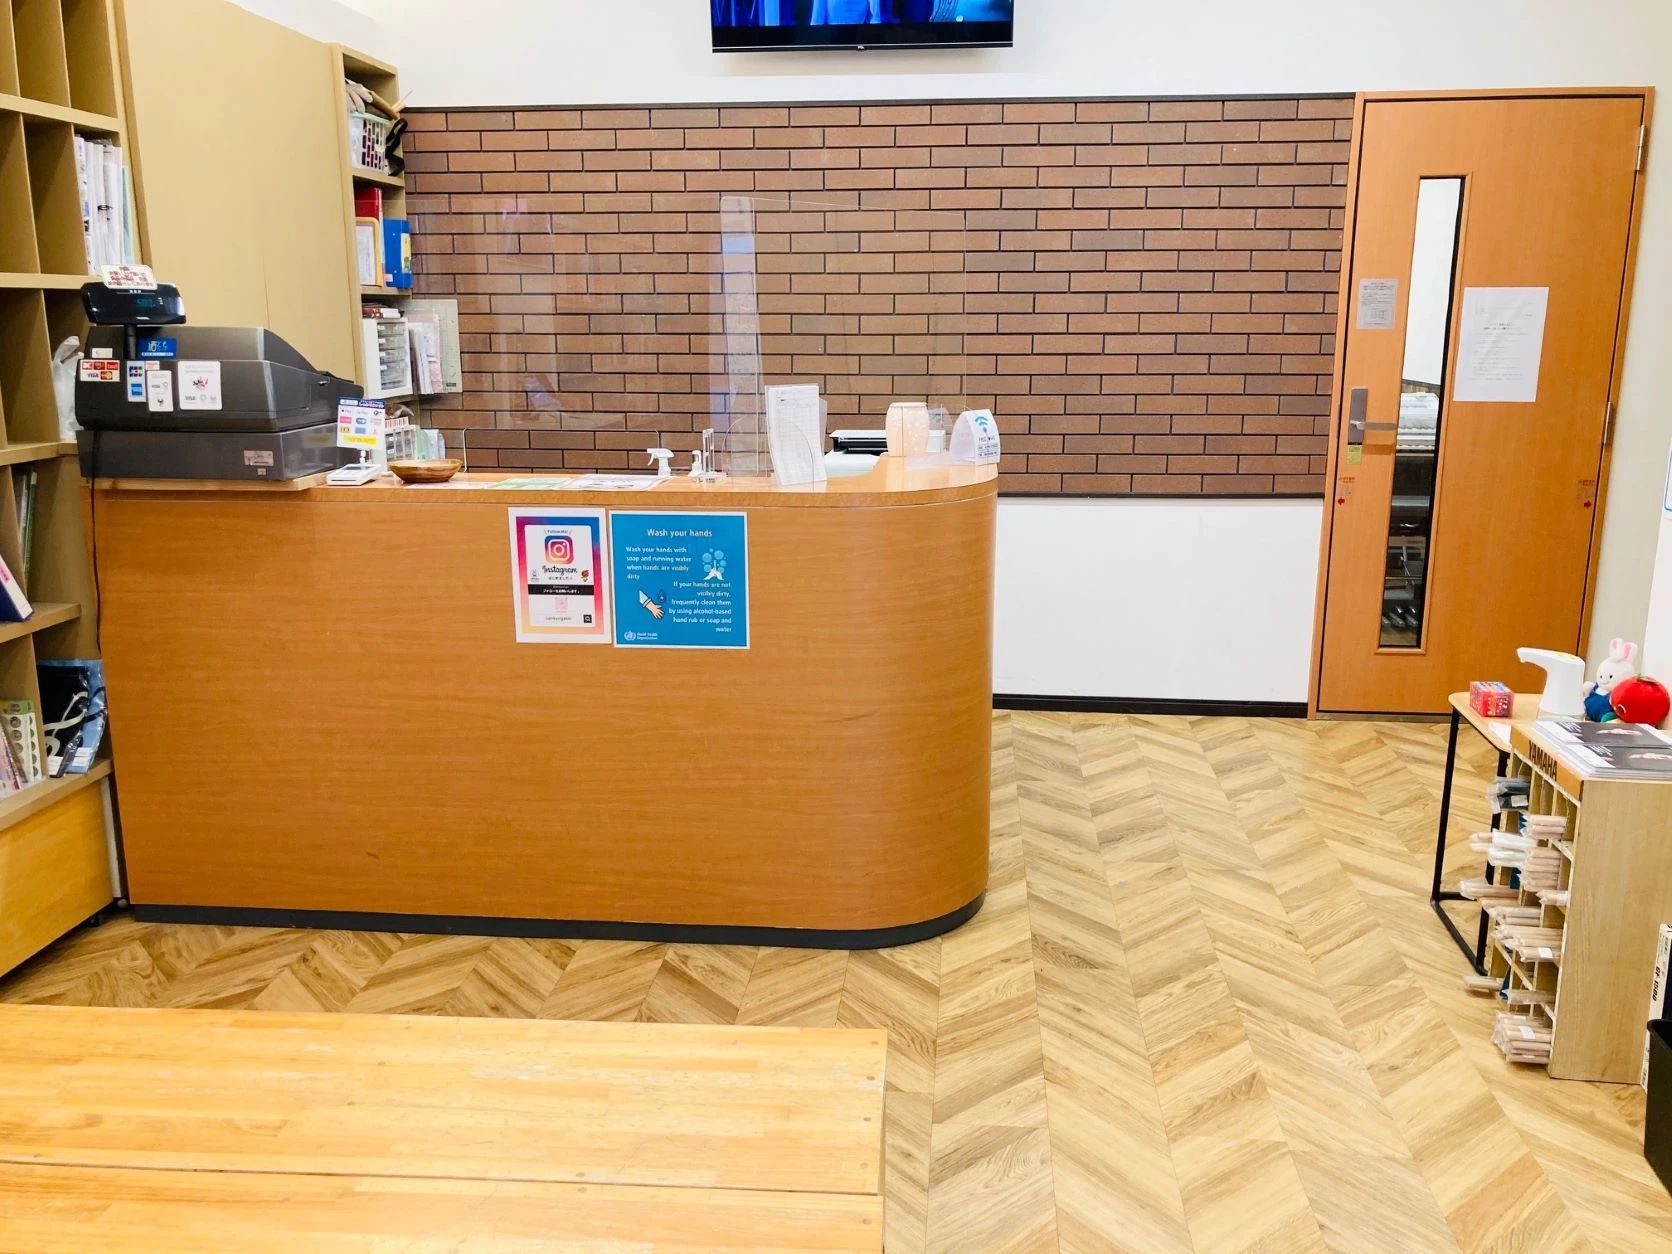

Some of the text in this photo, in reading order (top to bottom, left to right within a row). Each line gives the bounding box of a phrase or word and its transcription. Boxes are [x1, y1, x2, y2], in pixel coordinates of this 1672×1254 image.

[646, 528, 713, 539] Wash your hands
[542, 565, 577, 575] Instagram
[1528, 739, 1558, 782] YAMAHA
